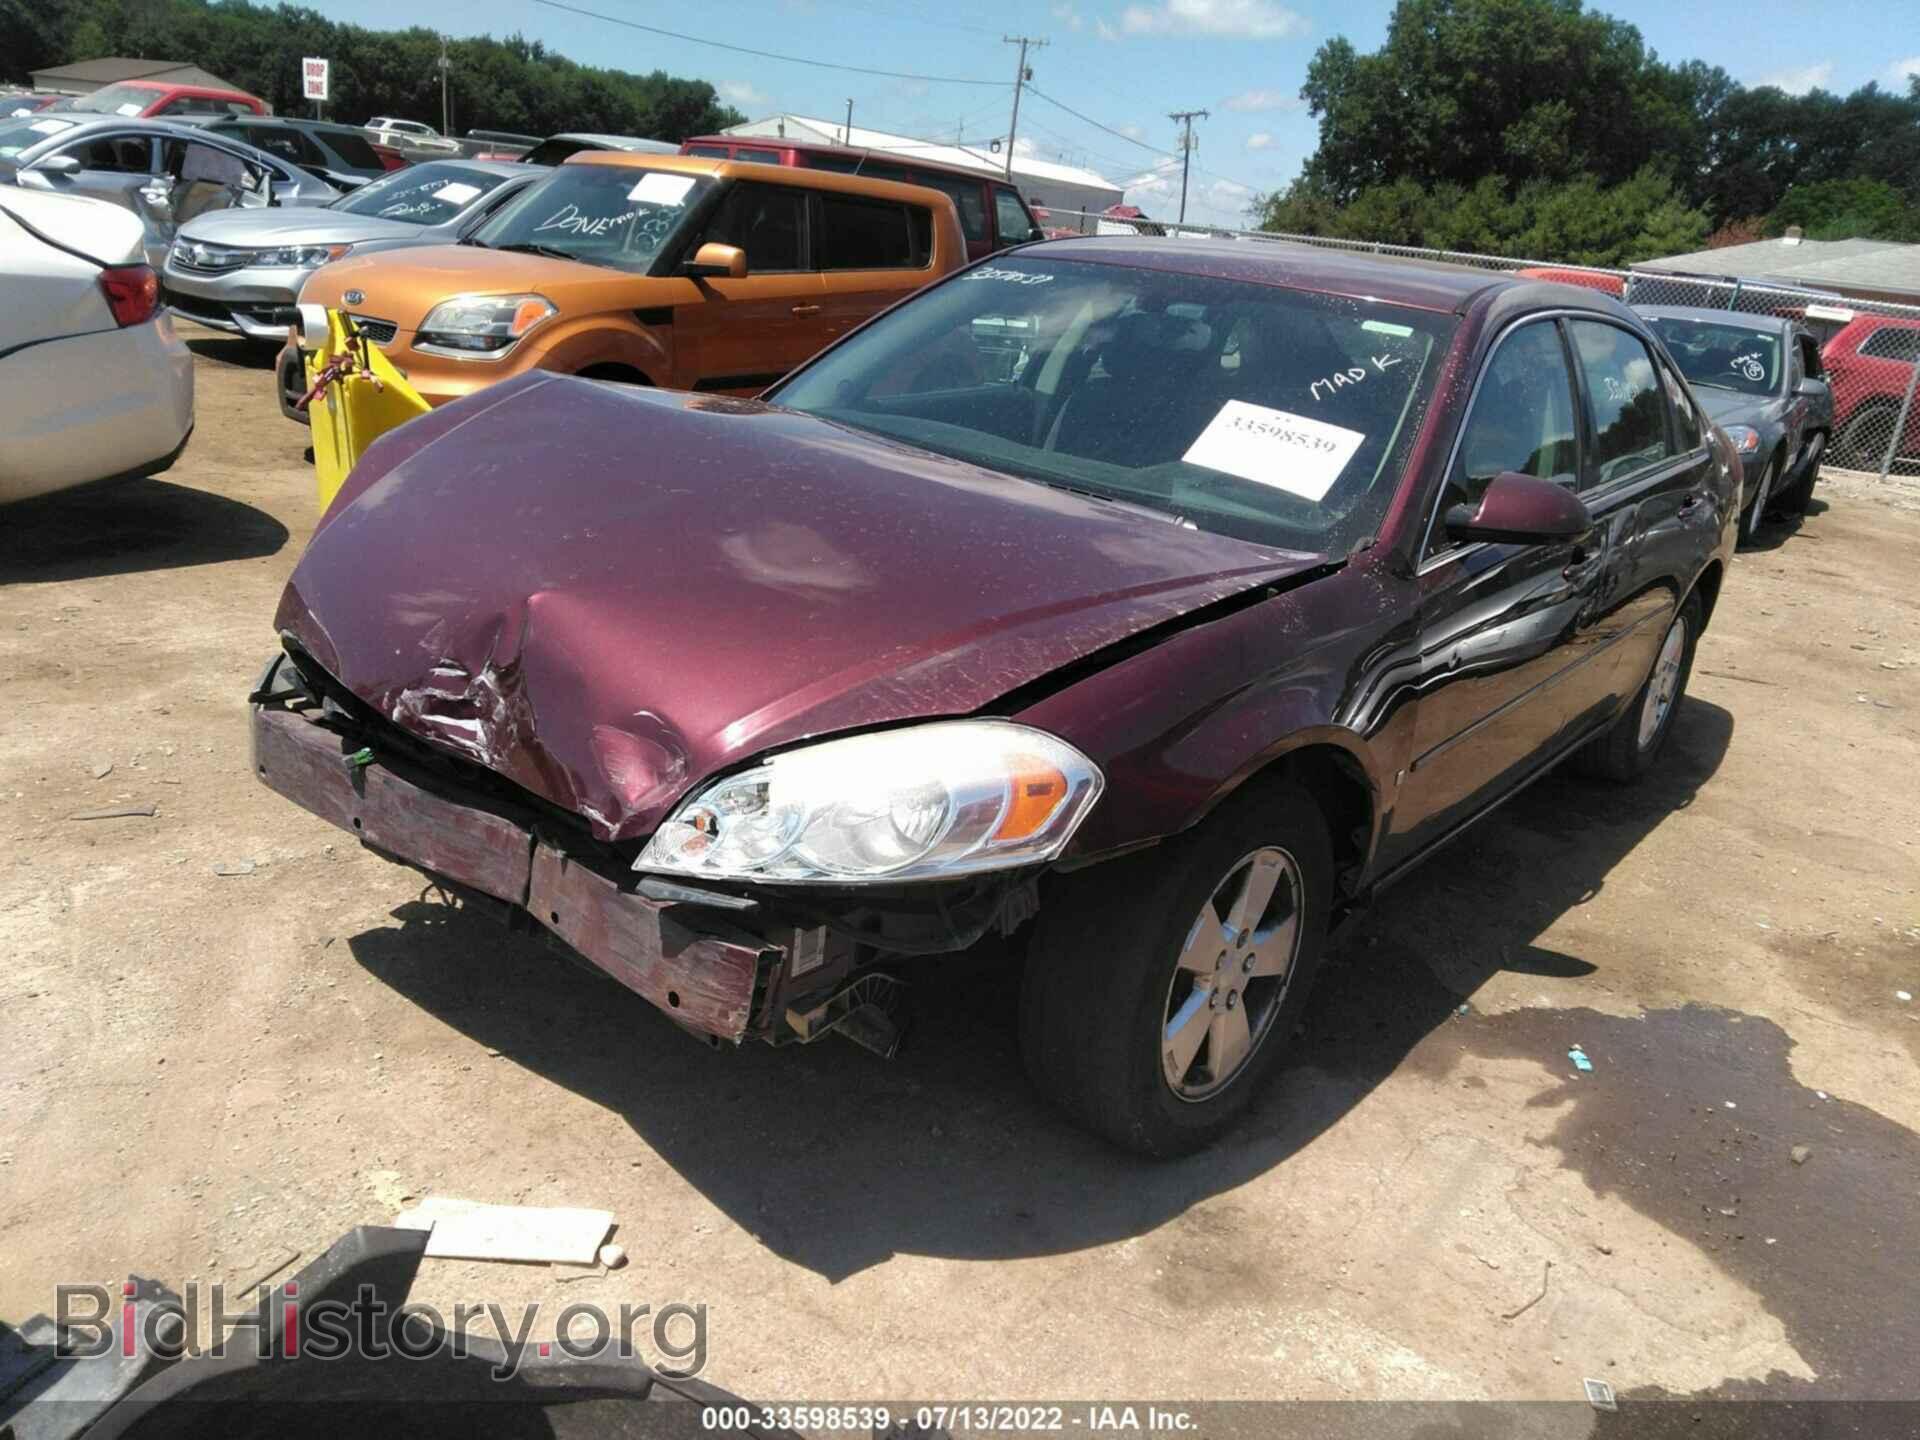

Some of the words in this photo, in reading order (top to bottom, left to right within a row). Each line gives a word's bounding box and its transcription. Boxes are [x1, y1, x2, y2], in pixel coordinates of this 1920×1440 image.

[1310, 367, 1366, 401] MAD
[1371, 353, 1403, 372] K
[1225, 416, 1337, 453] 33598539
